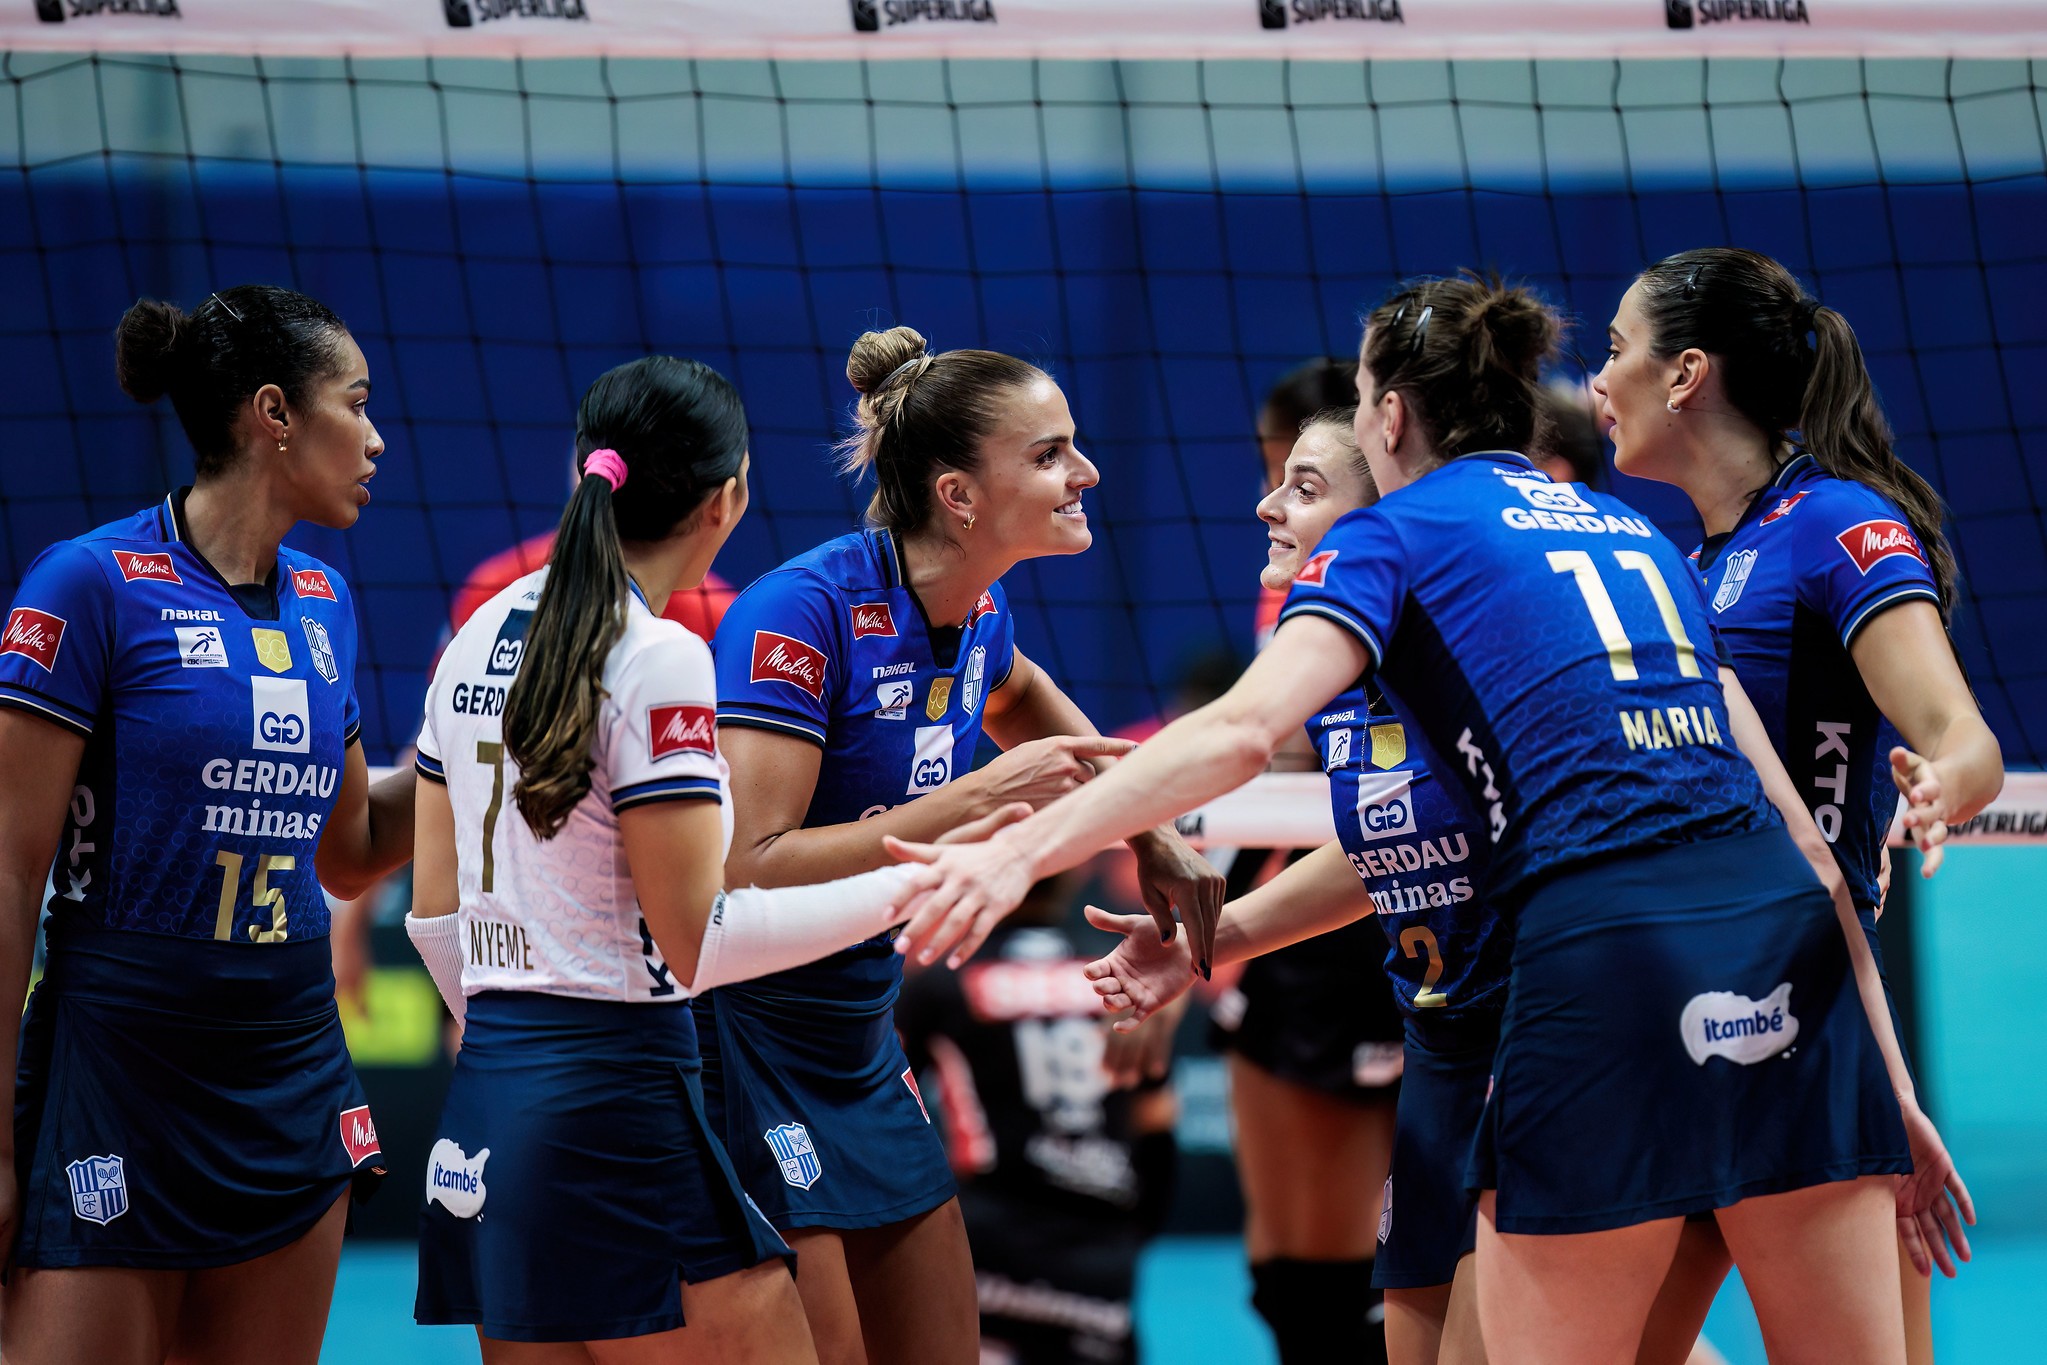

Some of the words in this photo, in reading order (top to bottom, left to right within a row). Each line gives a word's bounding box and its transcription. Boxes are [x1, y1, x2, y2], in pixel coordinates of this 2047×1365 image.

[1698, 0, 1810, 25] SUPERLIGA
[1501, 506, 1652, 538] GERDAU
[128, 556, 169, 574] Melitta
[1545, 550, 1702, 681] 11
[759, 643, 815, 685] Melitta
[452, 682, 505, 717] GERD
[1619, 706, 1724, 753] MARIA
[201, 758, 338, 799] GERDAU
[1814, 721, 1851, 843] KTO
[201, 799, 322, 841] minas
[476, 741, 504, 893] 7
[1947, 810, 2047, 836] UPERLIG
[62, 784, 96, 902] KTO
[1348, 832, 1470, 879] GERDAU
[214, 850, 296, 943] 15
[1368, 875, 1474, 915] minas
[470, 920, 534, 971] NYEME
[1400, 925, 1447, 1007] 2
[1703, 1006, 1783, 1043] itambé
[351, 1116, 377, 1150] Meli
[433, 1161, 478, 1194] itambé
